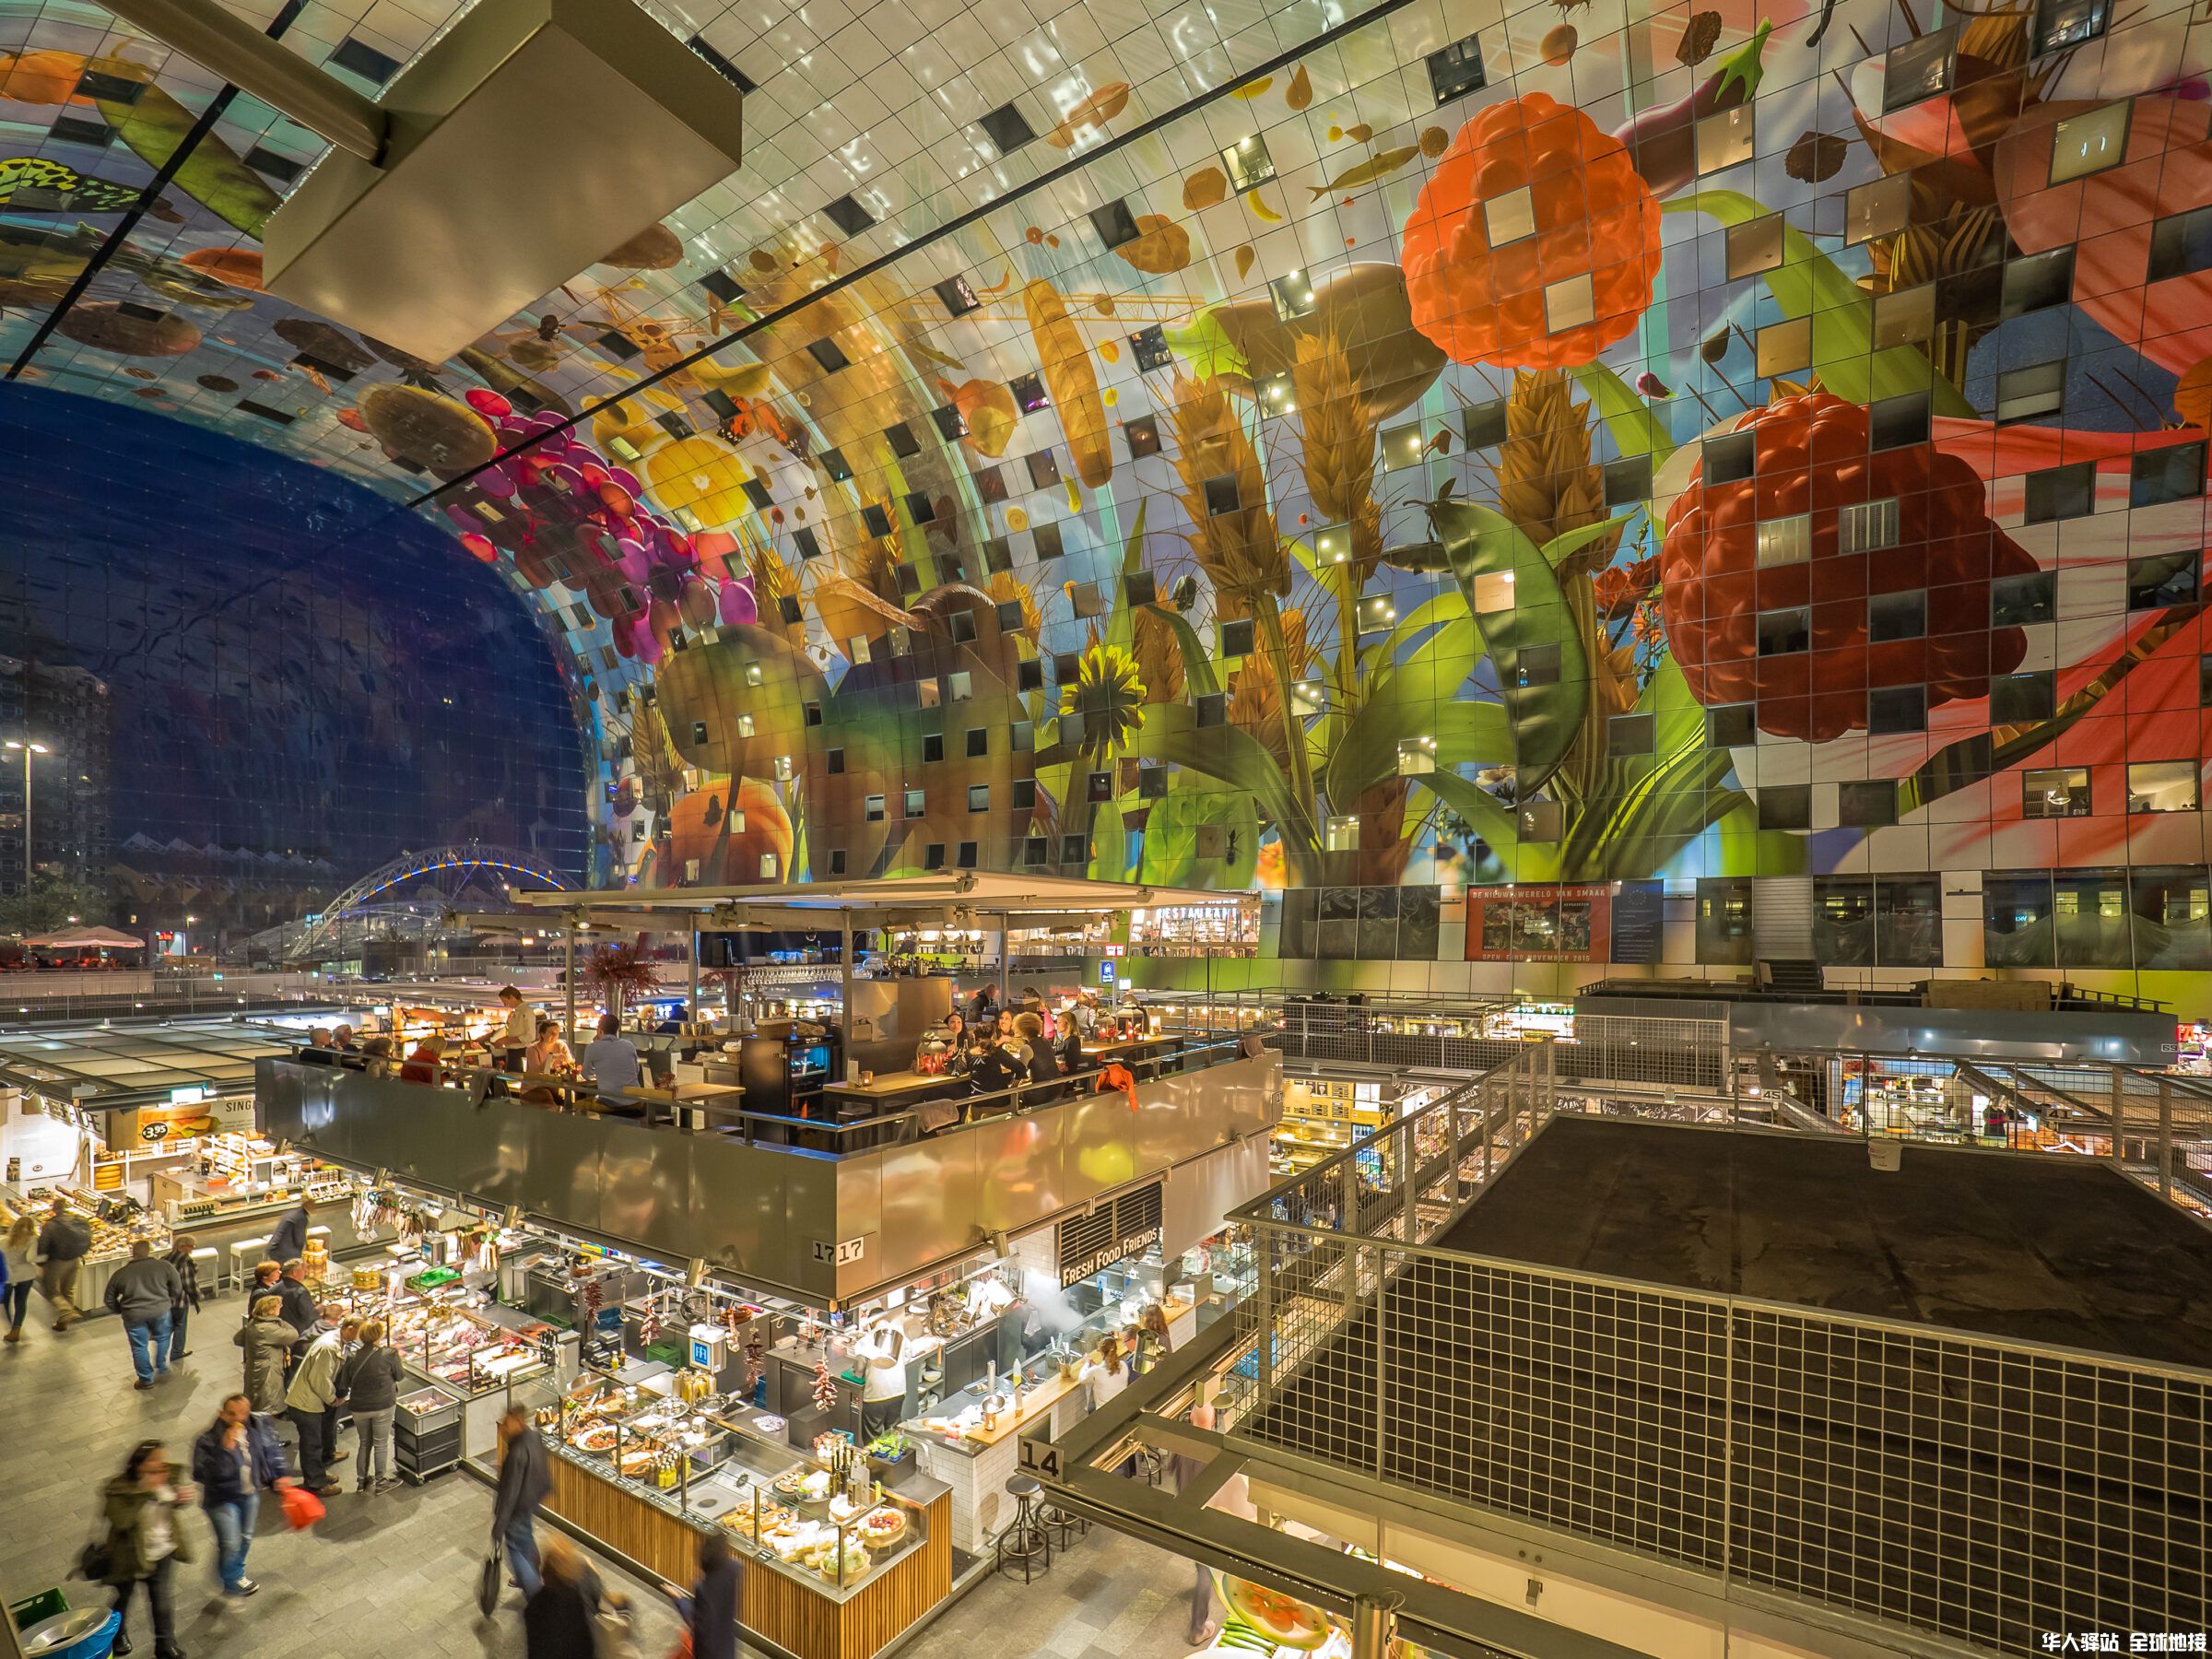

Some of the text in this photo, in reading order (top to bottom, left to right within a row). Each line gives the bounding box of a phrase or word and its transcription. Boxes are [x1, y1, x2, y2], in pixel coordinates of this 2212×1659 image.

[1518, 890, 1551, 899] WERELD
[1556, 890, 1572, 899] VAN
[1576, 888, 1606, 898] SMAAK
[1527, 954, 1569, 962] NOVEMBER
[814, 1242, 835, 1263] 17
[839, 1240, 862, 1263] 17
[1020, 1441, 1059, 1477] 14
